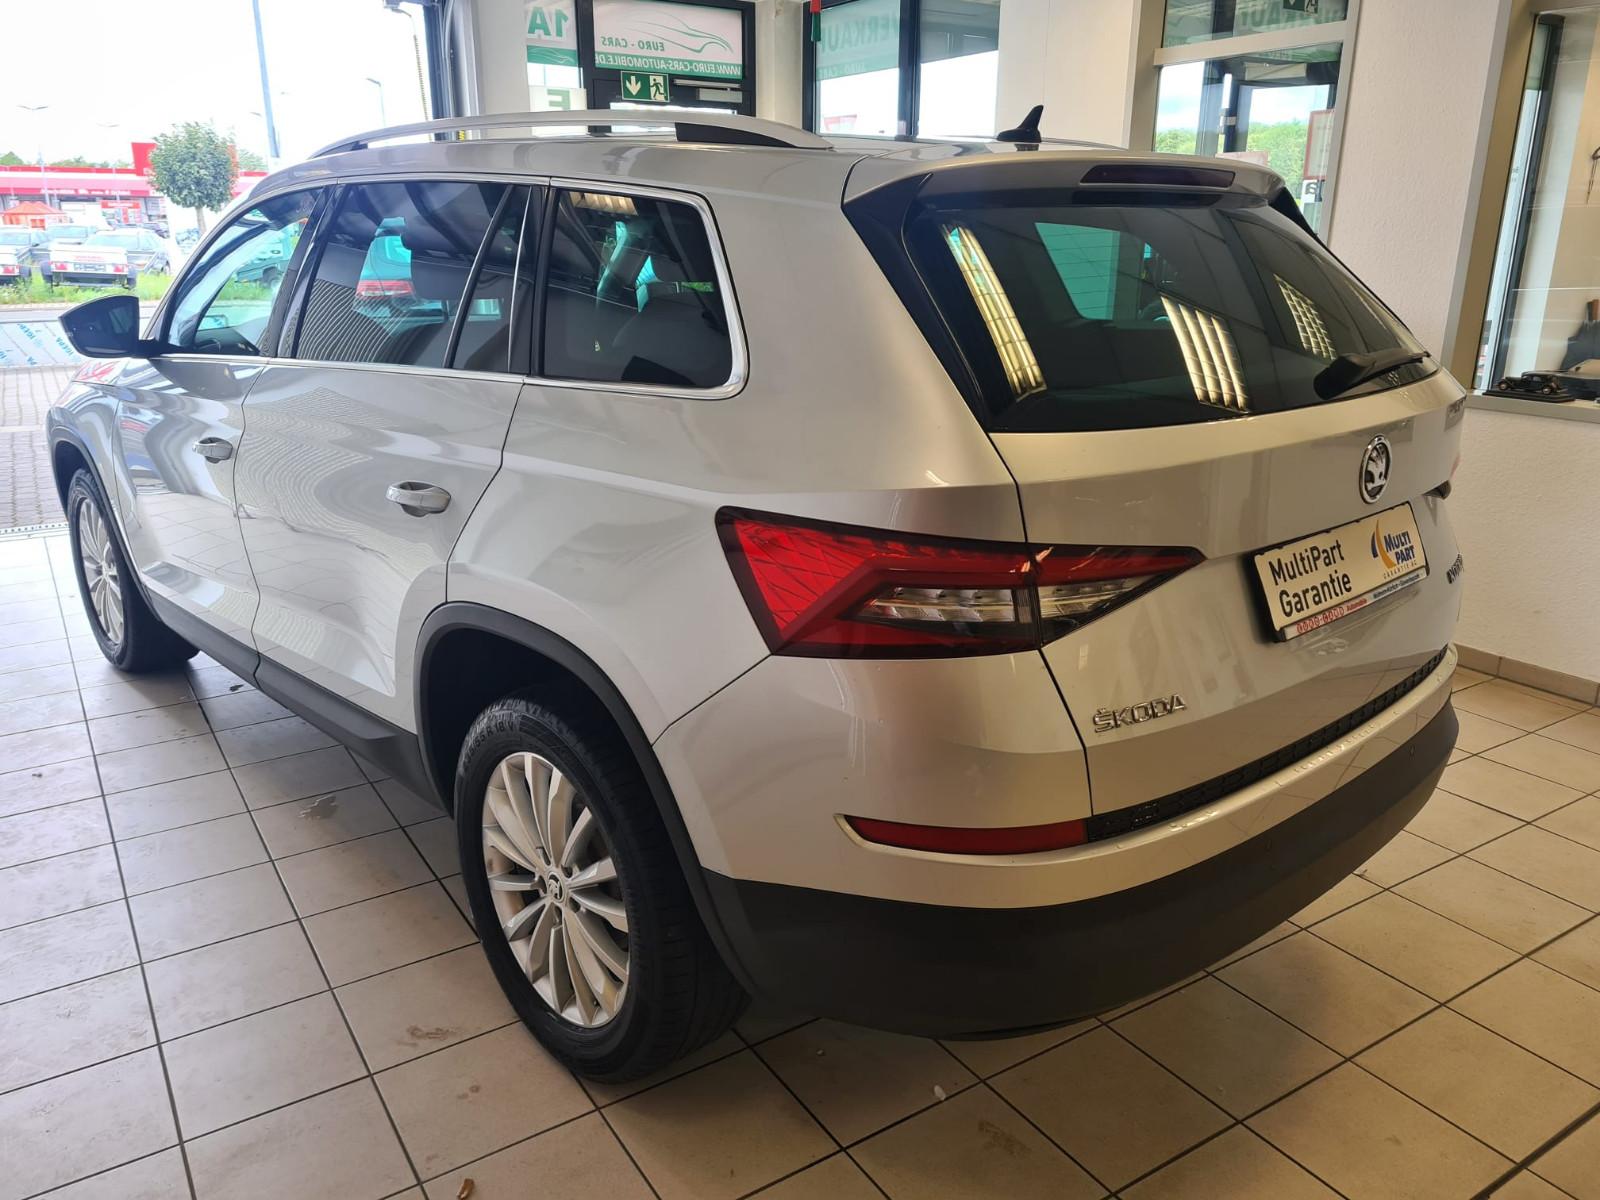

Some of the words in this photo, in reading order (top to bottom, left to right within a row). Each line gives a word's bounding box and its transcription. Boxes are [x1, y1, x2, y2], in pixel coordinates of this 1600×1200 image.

[1268, 539, 1345, 586] MultiPart
[1395, 544, 1415, 565] PART
[1278, 571, 1353, 618] Garantie
[1093, 693, 1187, 733] ŠKODA
